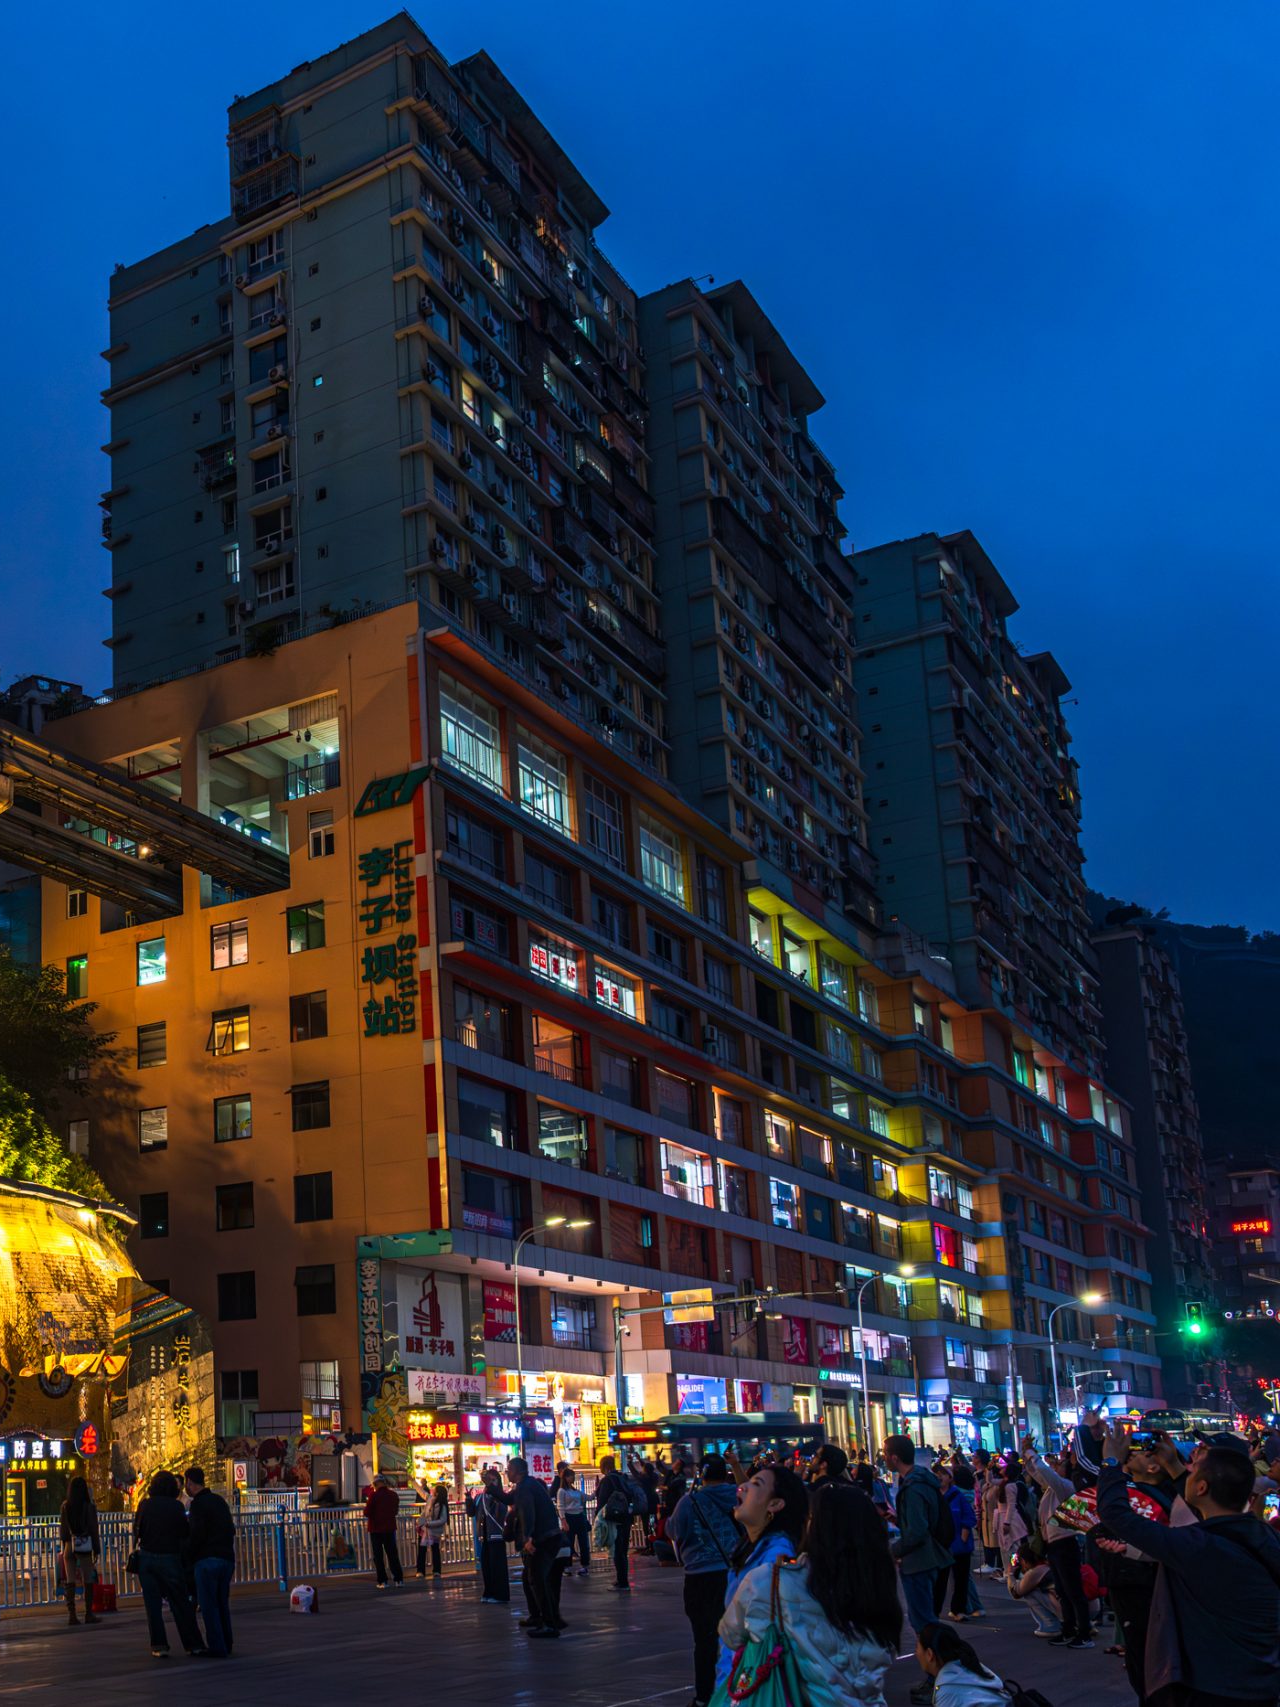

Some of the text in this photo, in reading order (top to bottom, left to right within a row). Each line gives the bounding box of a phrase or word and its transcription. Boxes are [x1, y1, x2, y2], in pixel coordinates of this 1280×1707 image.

[358, 847, 401, 1037] 李子坝站
[394, 840, 419, 1034] Liziba Station
[360, 1260, 382, 1372] 李子坝文创园
[408, 1424, 460, 1440] 怪味胡豆
